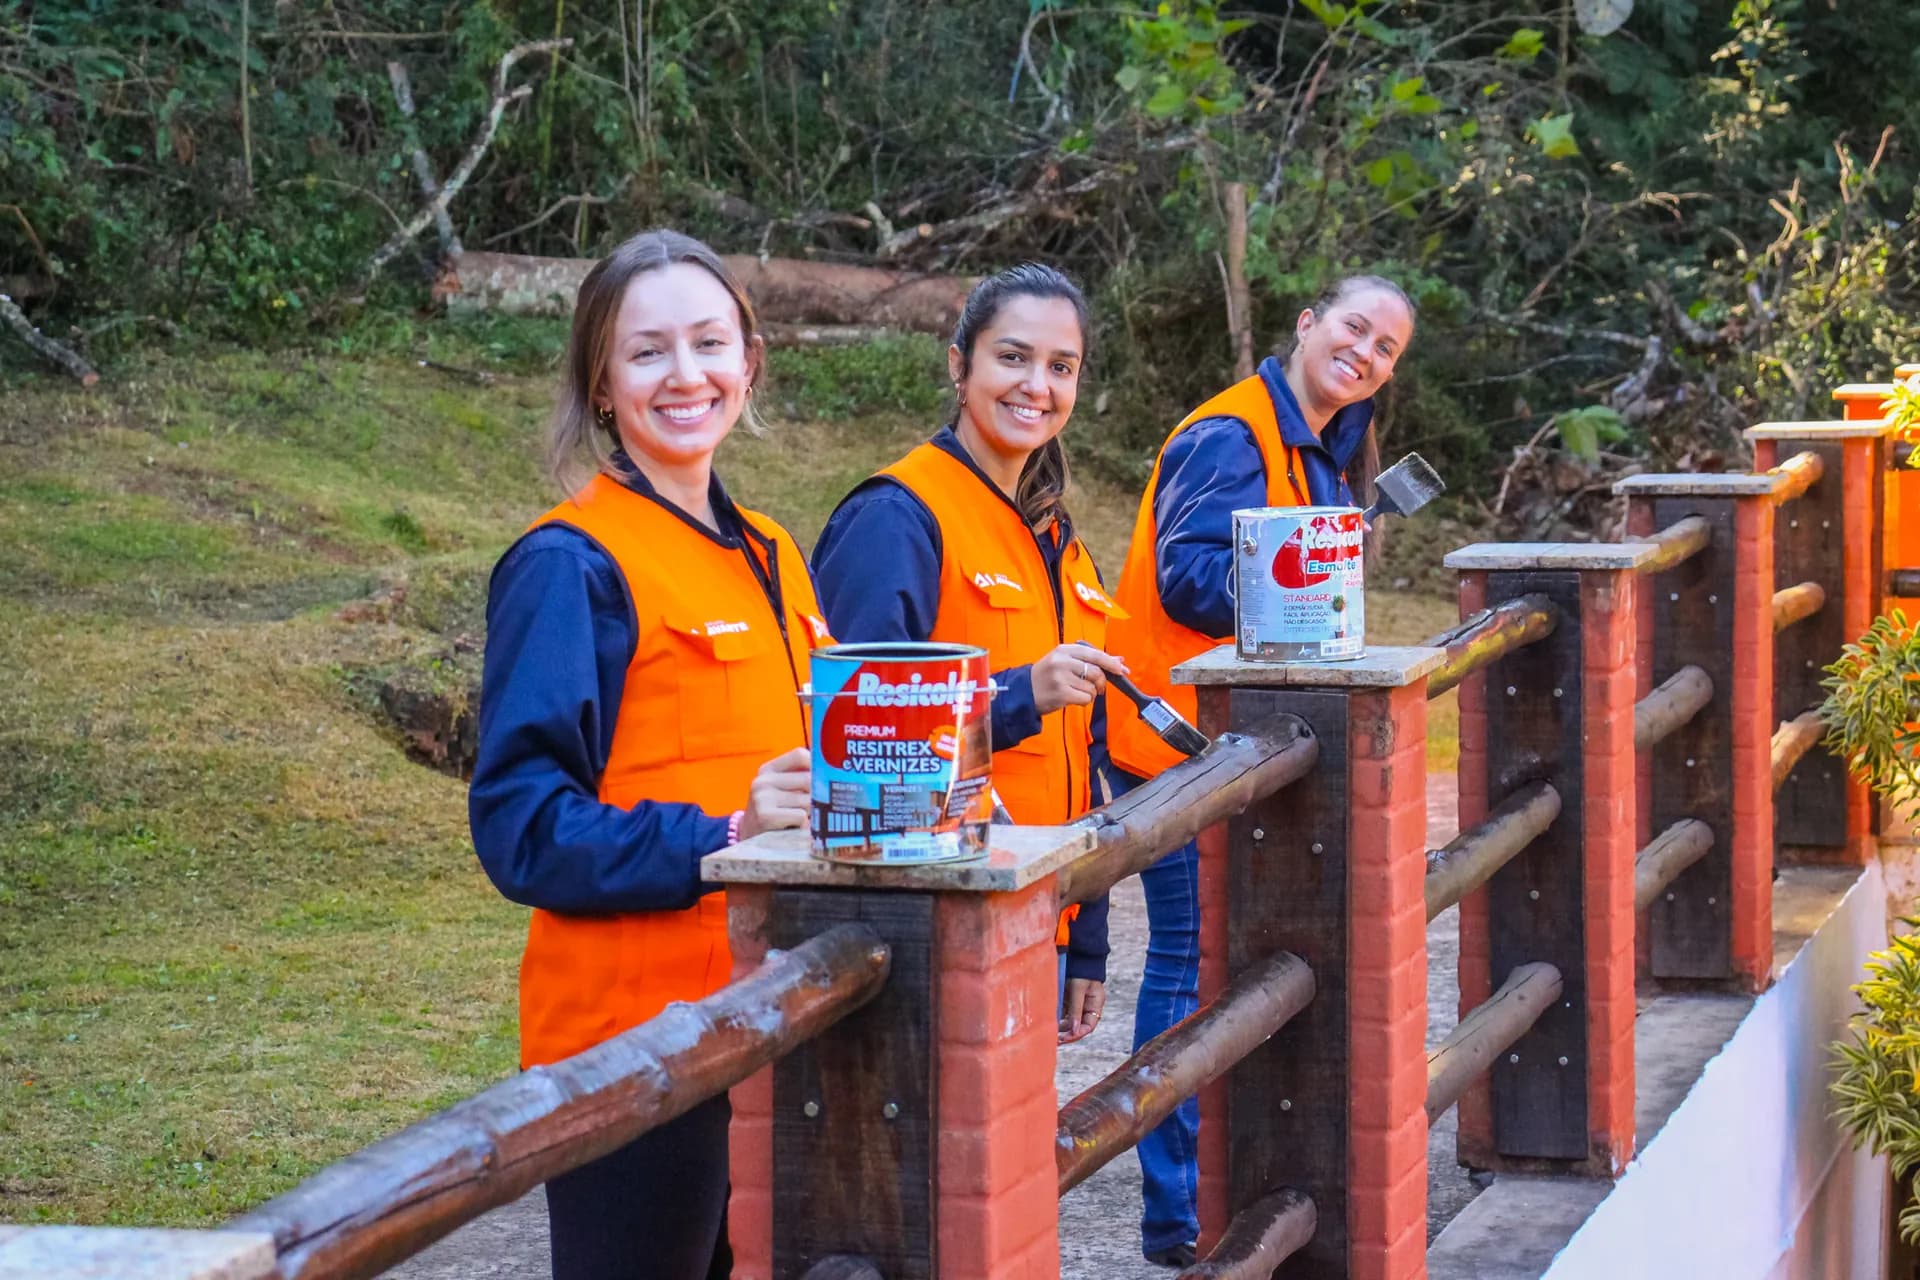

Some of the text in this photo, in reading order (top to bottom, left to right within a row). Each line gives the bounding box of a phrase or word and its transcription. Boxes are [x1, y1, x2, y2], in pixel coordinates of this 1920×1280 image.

[1283, 594, 1331, 603] STANDARD
[844, 724, 896, 737] PREMIUM
[847, 740, 932, 756] RESITREX
[852, 757, 941, 773] VERNIZES
